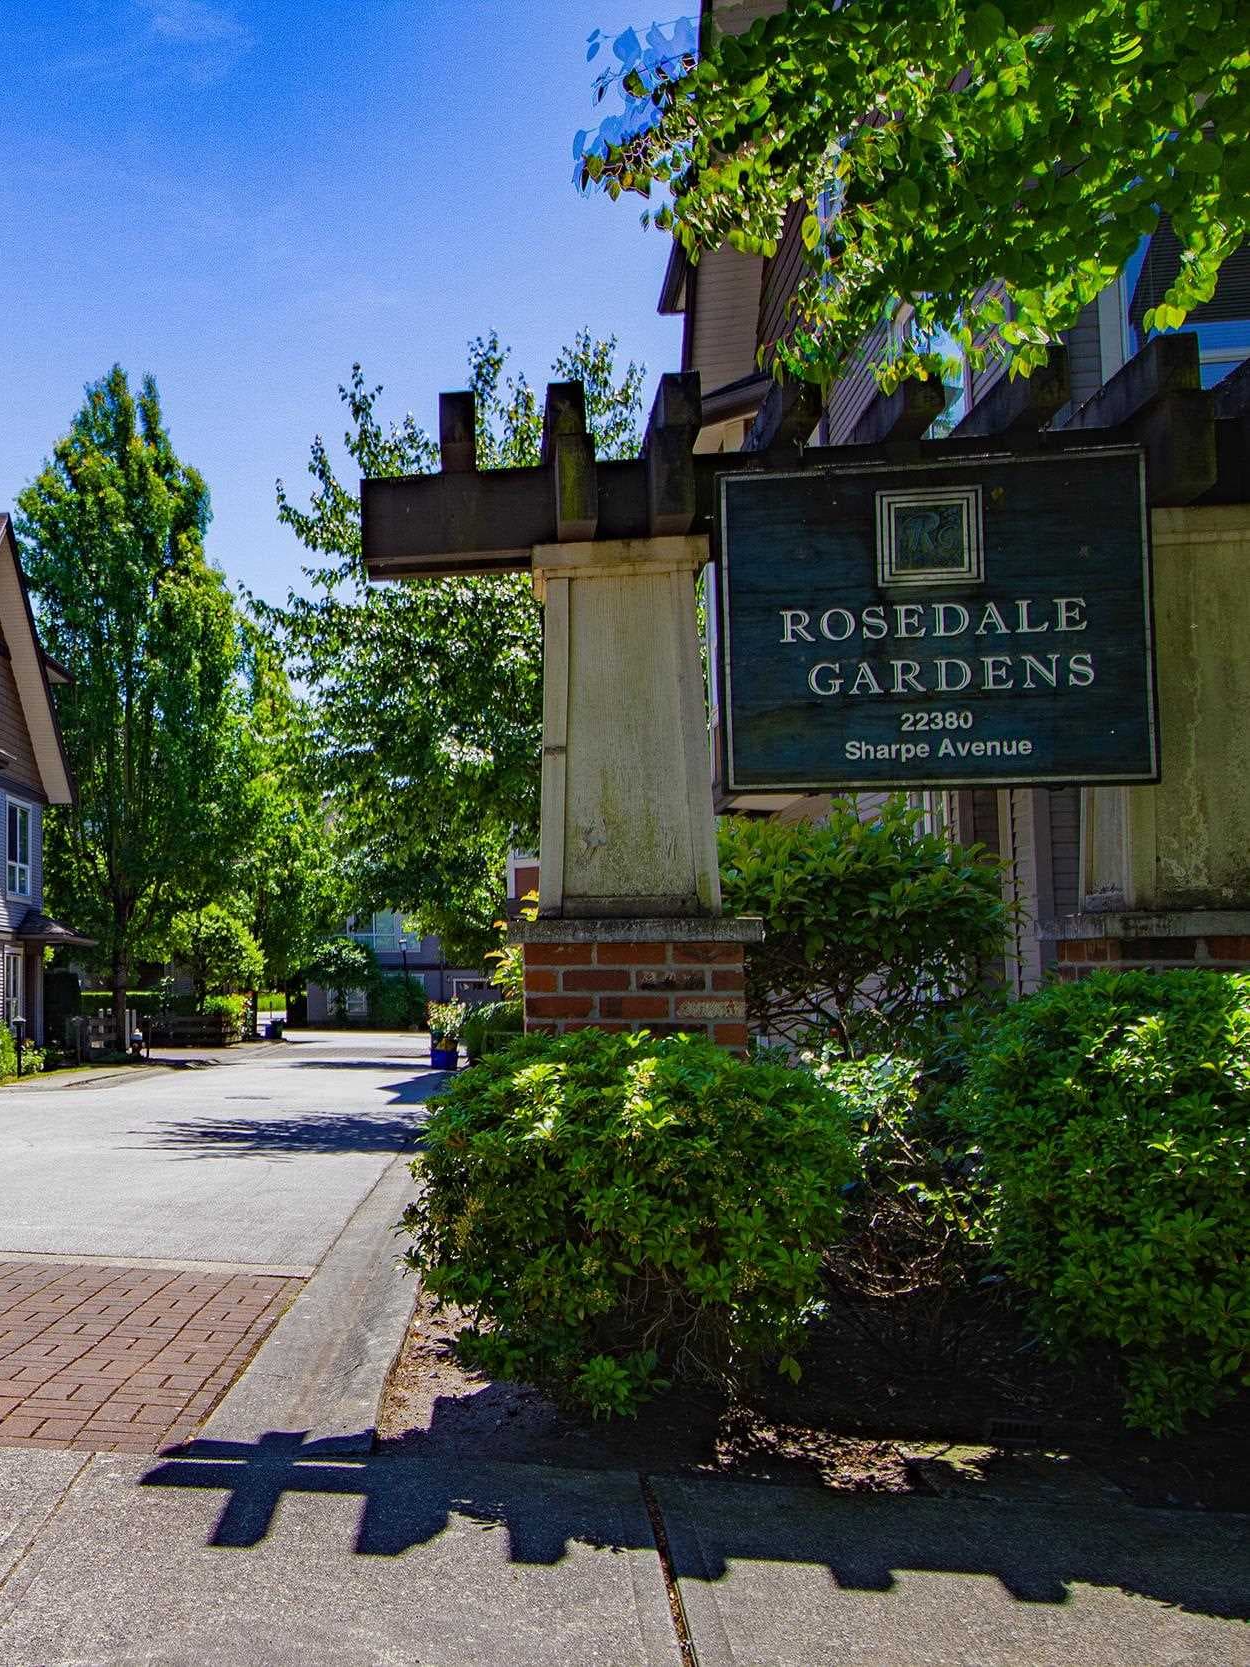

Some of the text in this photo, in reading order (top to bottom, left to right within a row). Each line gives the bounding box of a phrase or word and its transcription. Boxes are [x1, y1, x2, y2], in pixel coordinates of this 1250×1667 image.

[779, 598, 1088, 643] ROSEDALE
[807, 653, 1095, 696] GARDENS
[900, 711, 973, 732] 22380
[845, 737, 1032, 763] Sharpe Avenue
